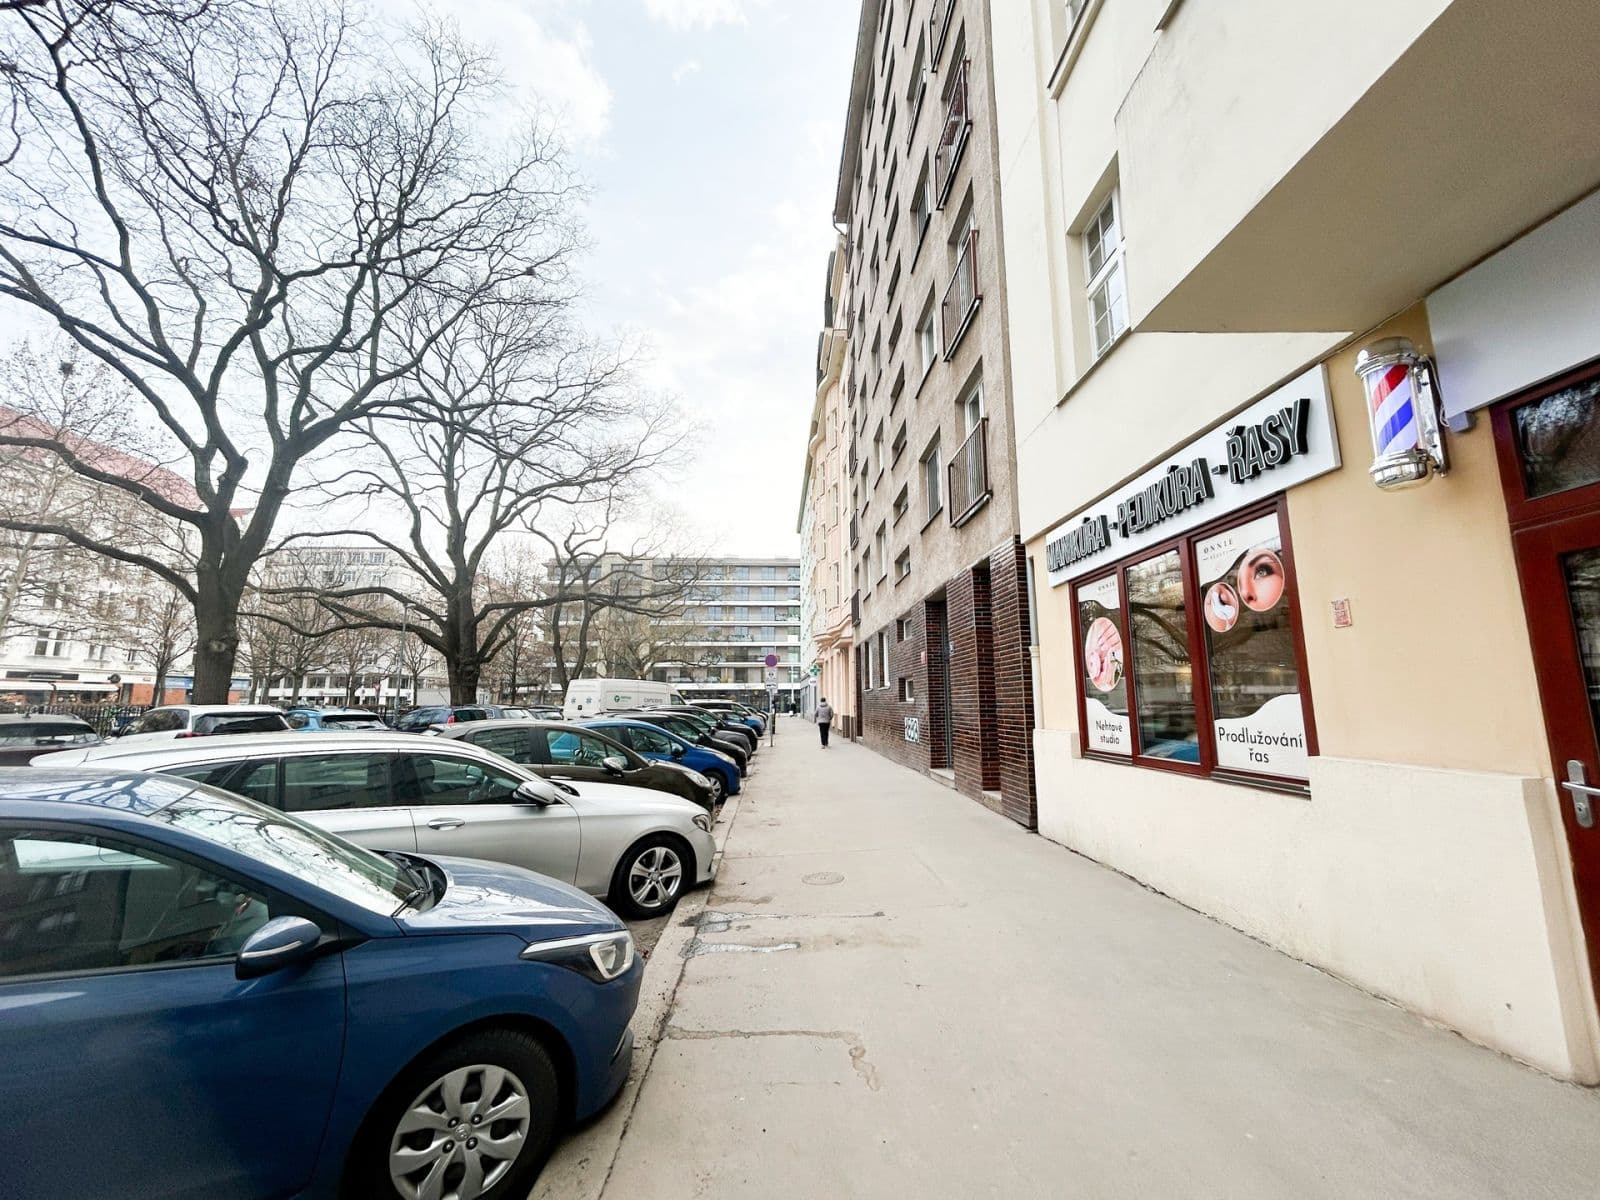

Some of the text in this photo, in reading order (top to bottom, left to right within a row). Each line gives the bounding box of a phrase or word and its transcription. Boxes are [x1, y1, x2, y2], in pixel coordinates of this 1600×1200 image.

[1117, 458, 1214, 538] PEDIKÚRA
[1226, 398, 1310, 484] ŘASY
[1095, 720, 1123, 732] Nehtové
[1100, 733, 1120, 745] studio
[1218, 726, 1303, 748] Prodlužování
[1249, 747, 1270, 763] řas
